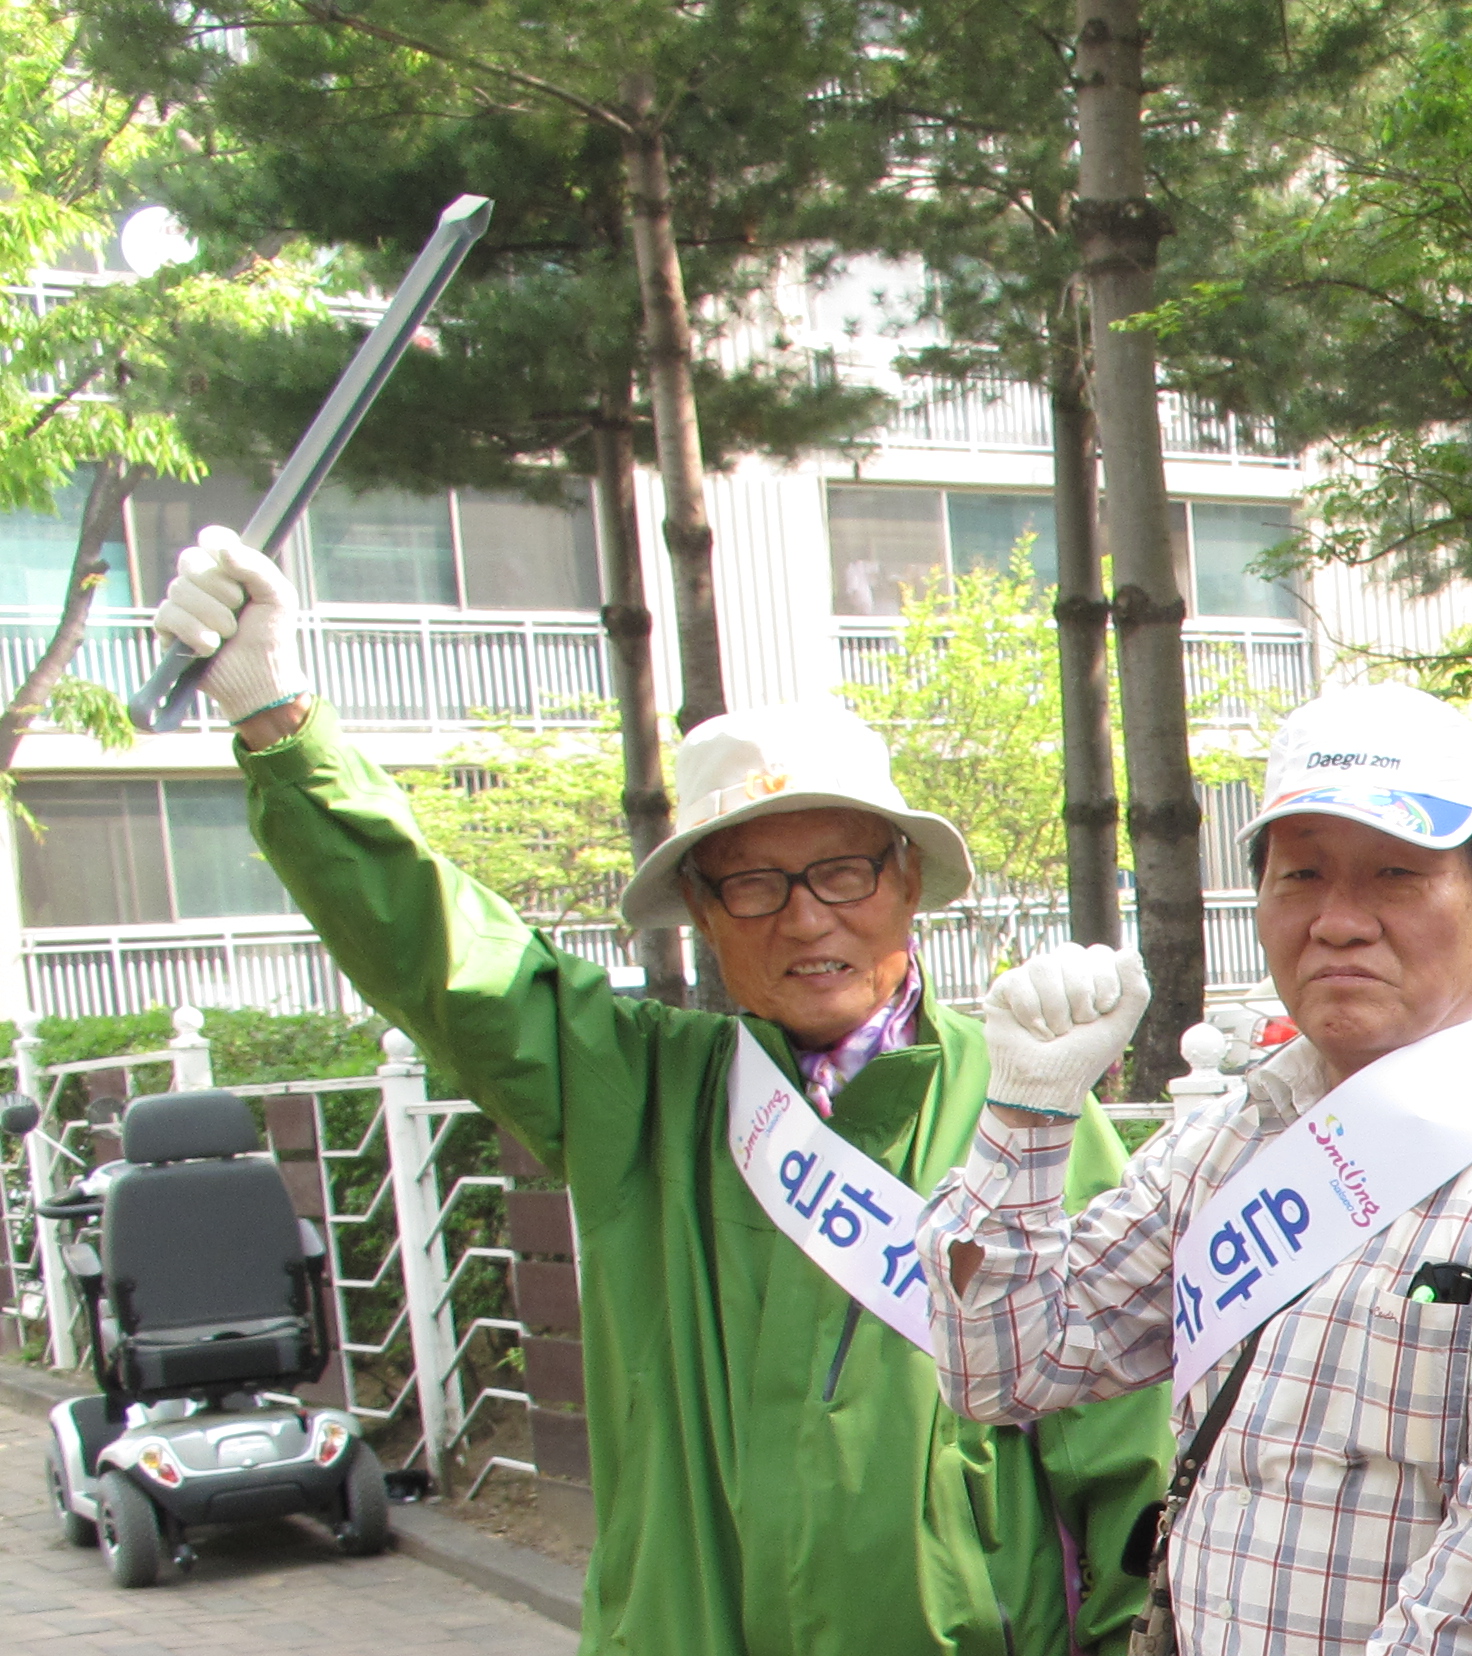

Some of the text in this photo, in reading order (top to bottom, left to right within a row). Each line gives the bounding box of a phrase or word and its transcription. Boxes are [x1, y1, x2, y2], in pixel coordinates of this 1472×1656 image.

[1306, 751, 1401, 771] Daegu 2011
[1308, 1113, 1381, 1229] Smiling
[1329, 1178, 1354, 1212] Dalseo
